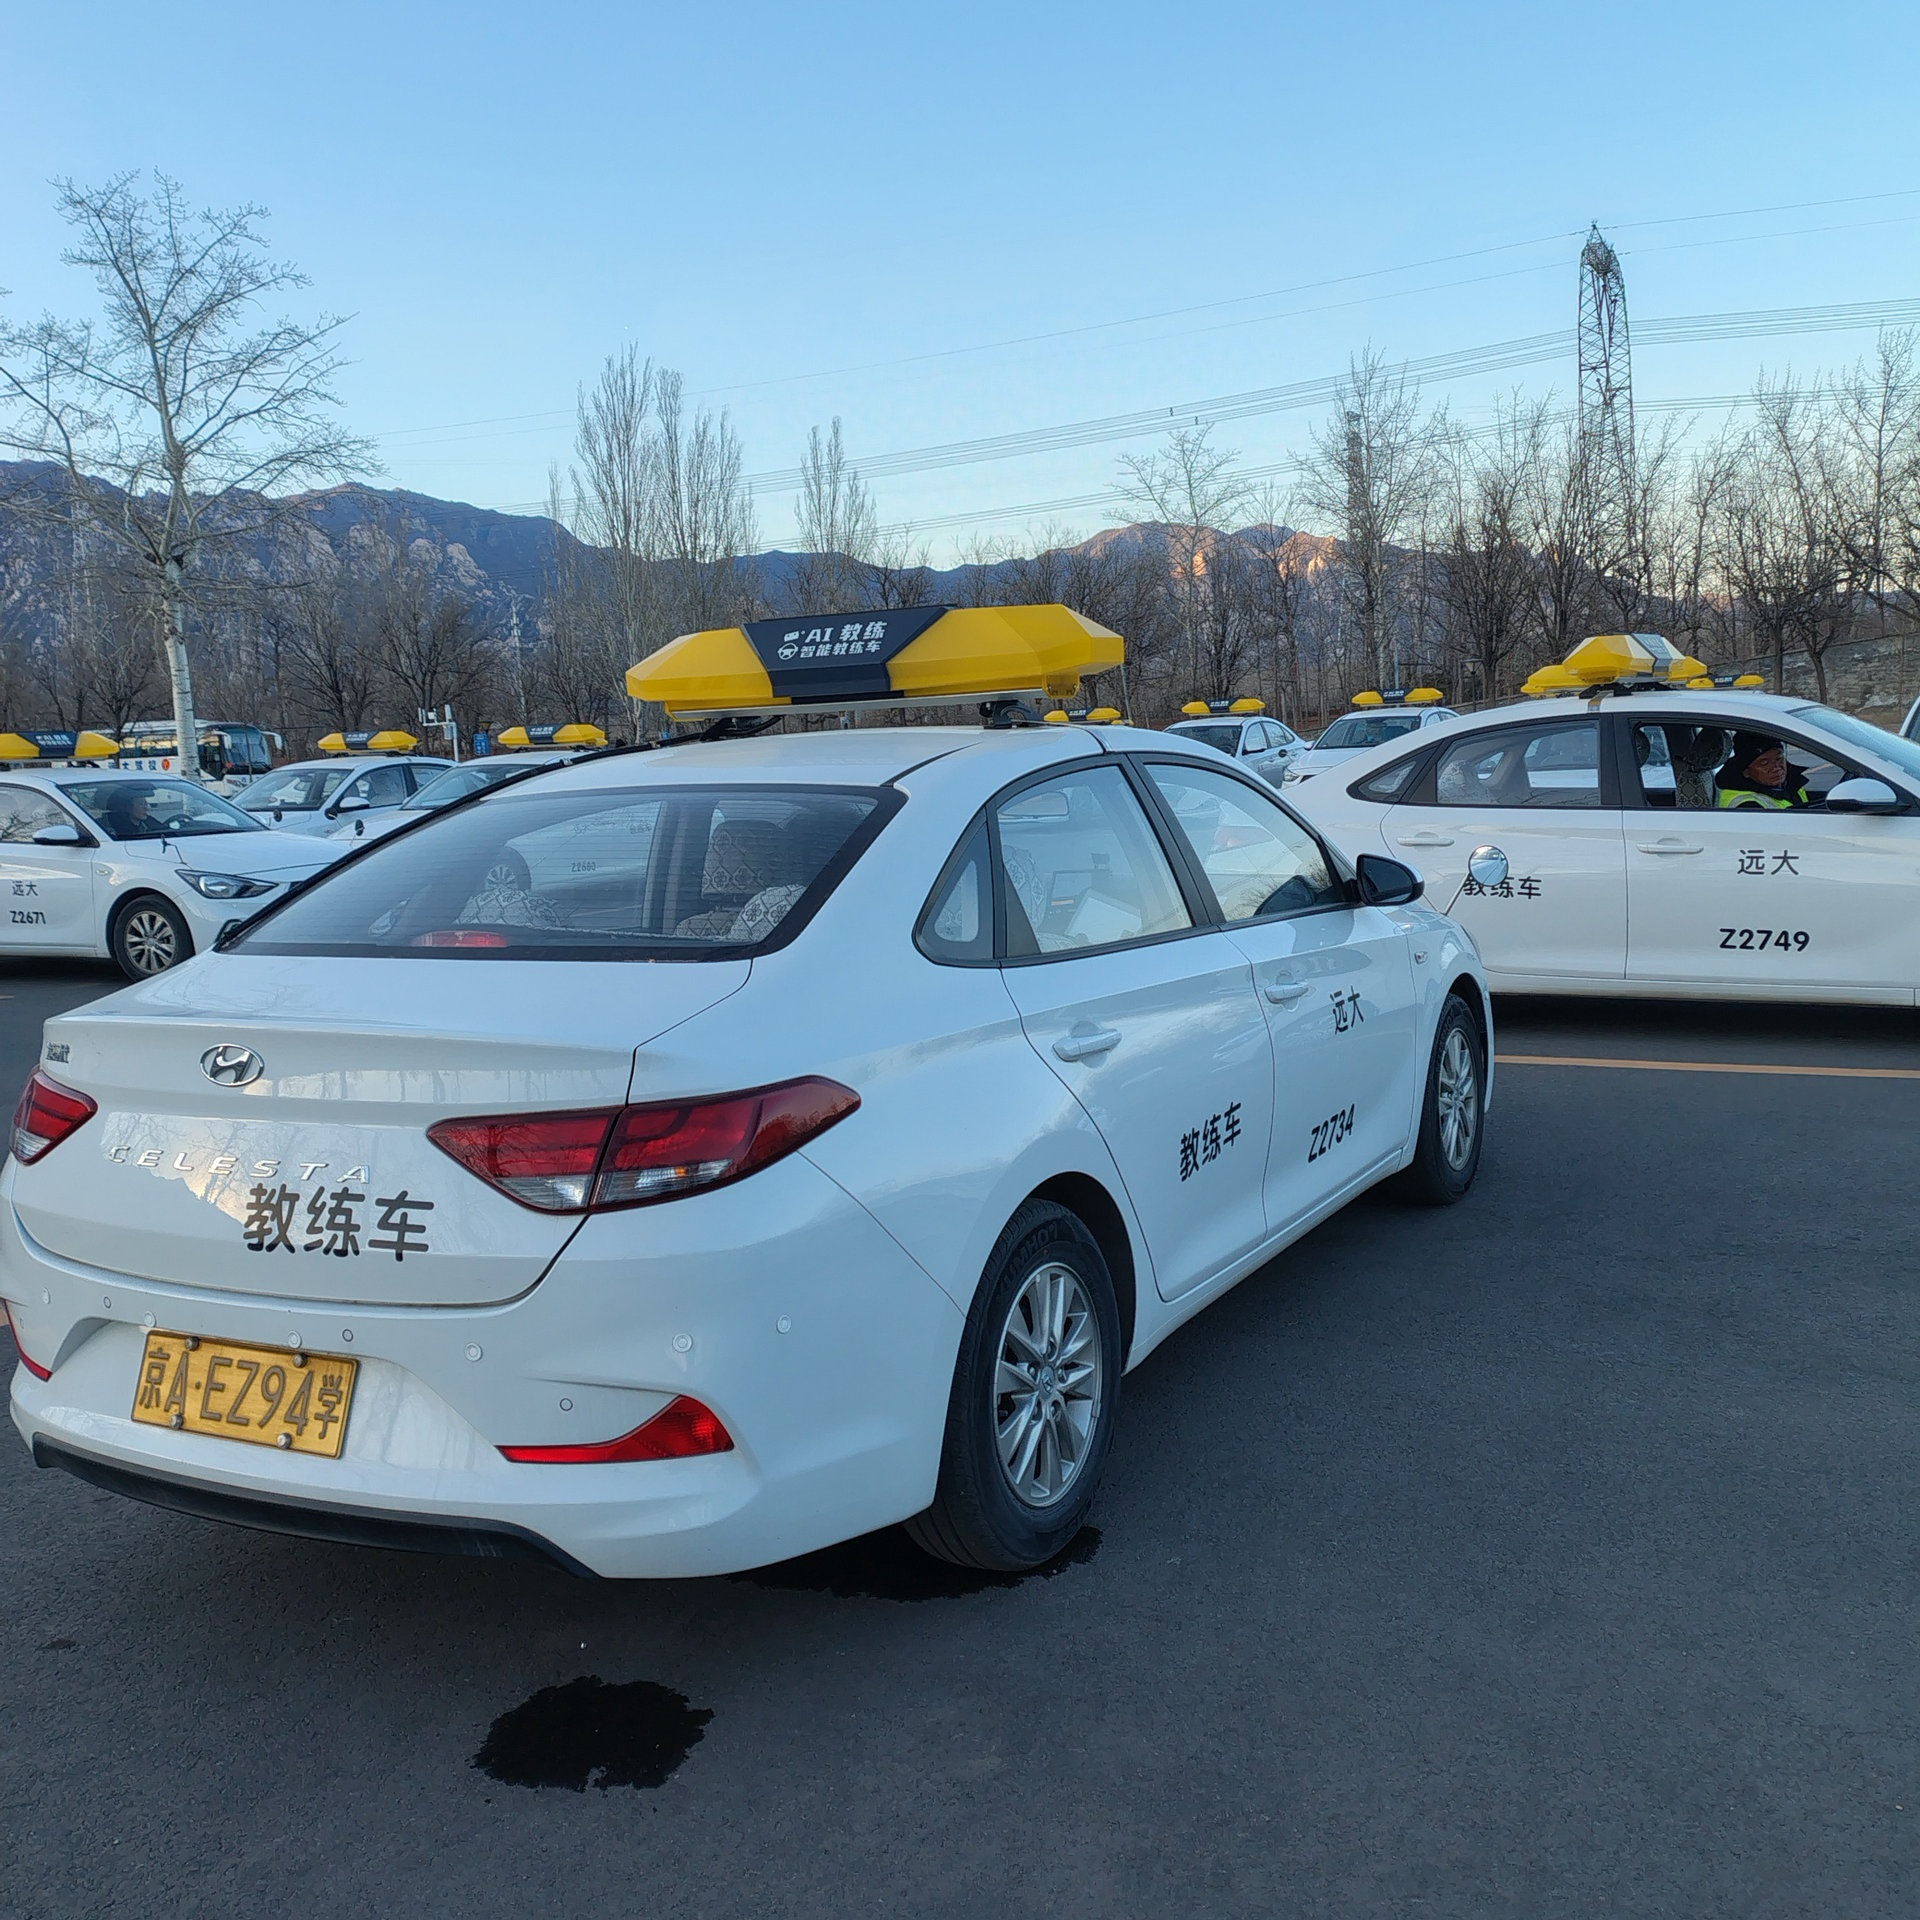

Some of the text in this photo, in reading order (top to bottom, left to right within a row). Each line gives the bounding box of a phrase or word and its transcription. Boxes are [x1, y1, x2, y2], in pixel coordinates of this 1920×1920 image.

[805, 621, 888, 643] AI 教练
[800, 640, 882, 658] 智能教练车
[1737, 849, 1800, 876] 远大
[11, 880, 39, 897] 远大
[9, 910, 47, 925] Z2671
[1719, 928, 1811, 952] Z2749
[1330, 985, 1365, 1036] 远大
[1179, 1101, 1242, 1182] 教练车
[1308, 1103, 1355, 1163] Z2734
[108, 1146, 371, 1184] CELESTA
[243, 1183, 434, 1262] 教练车
